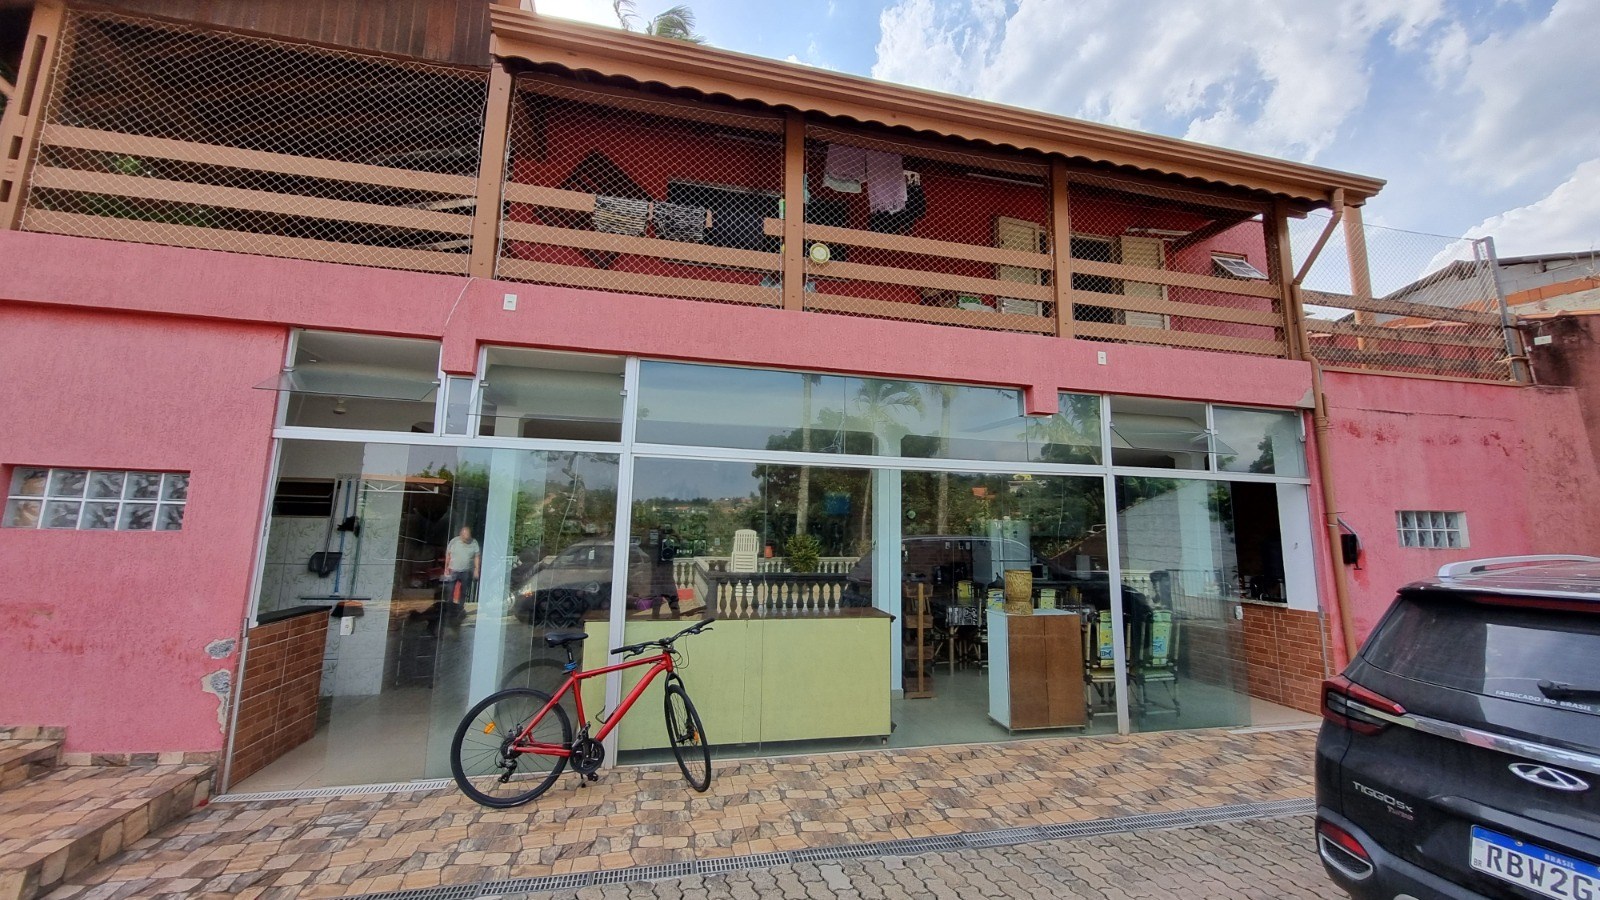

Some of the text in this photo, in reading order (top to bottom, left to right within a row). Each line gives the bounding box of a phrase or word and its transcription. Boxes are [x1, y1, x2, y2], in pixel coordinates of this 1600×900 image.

[1495, 690, 1540, 702] FABRICADO
[1560, 701, 1591, 711] BRASIL
[1353, 781, 1395, 805] TIGGO
[1486, 844, 1600, 900] RBW2G
[1544, 853, 1576, 869] BRASIL
